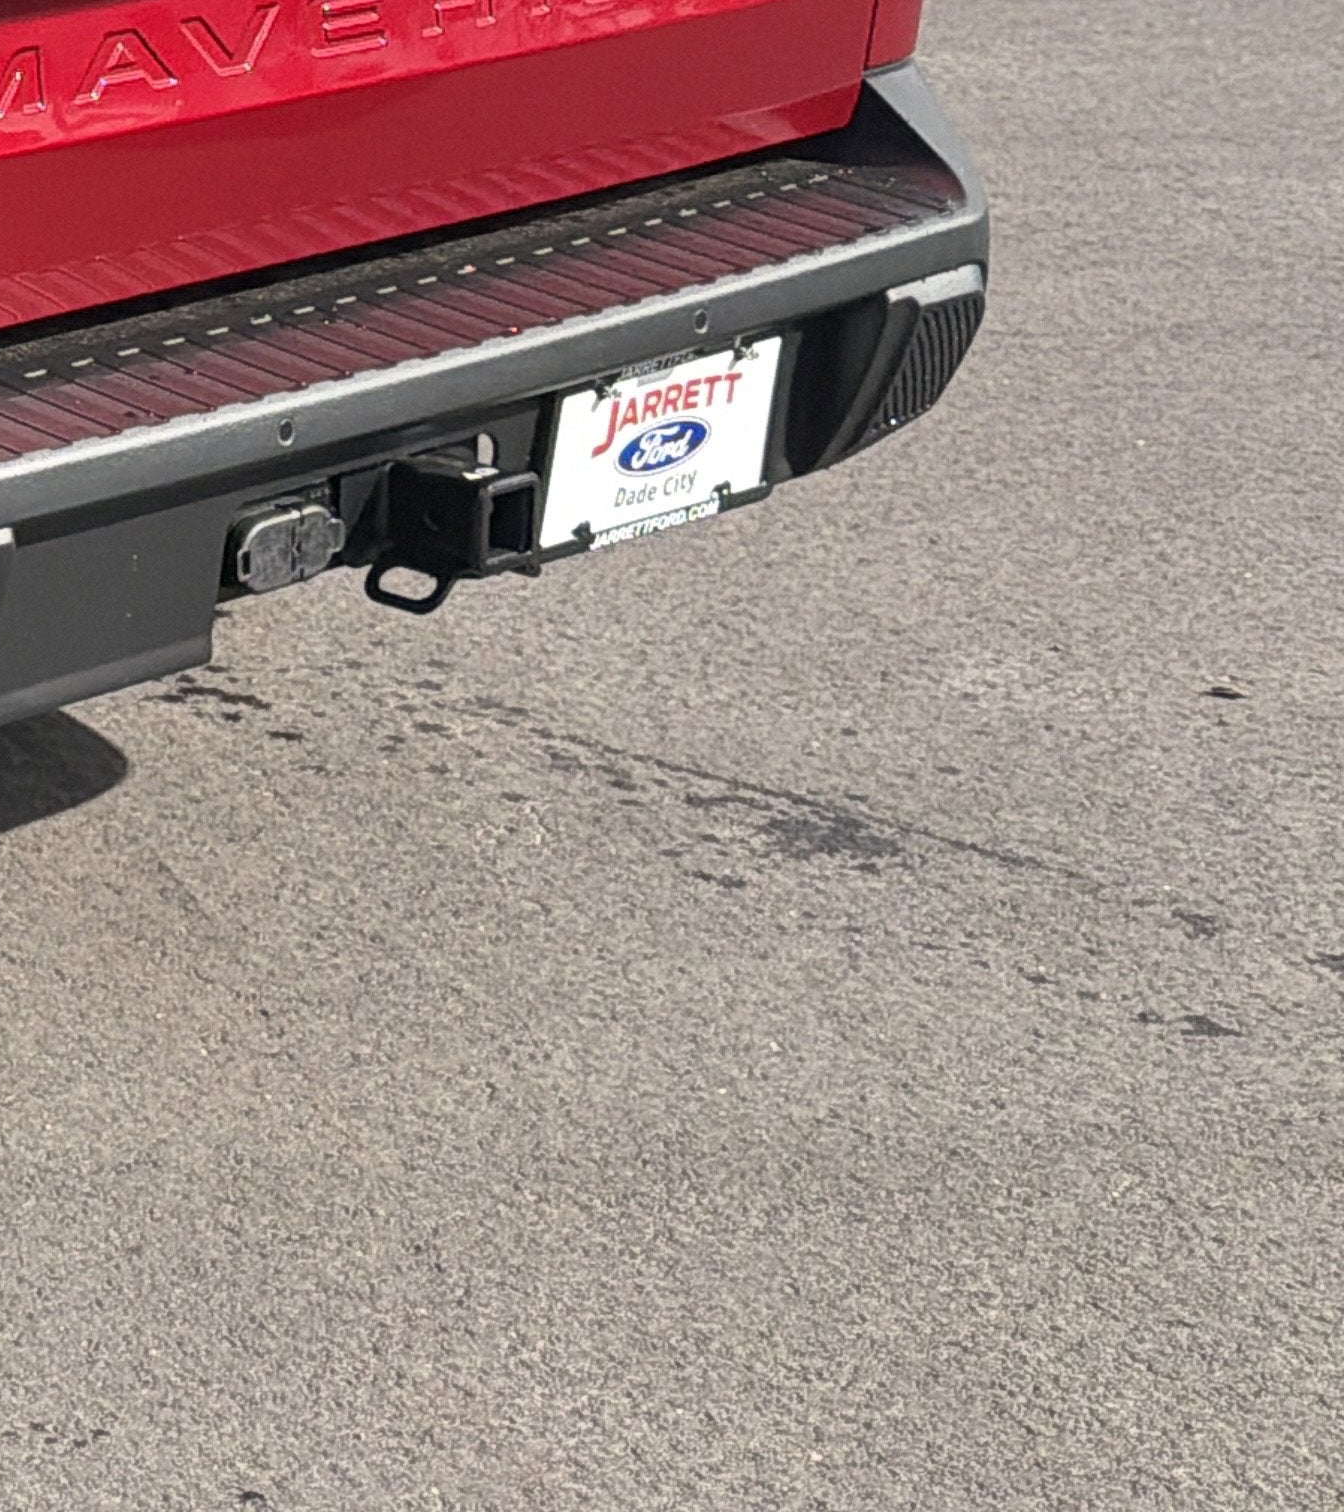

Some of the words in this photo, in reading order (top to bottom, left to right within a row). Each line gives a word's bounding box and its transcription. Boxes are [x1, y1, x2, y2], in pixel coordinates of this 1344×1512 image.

[591, 372, 744, 458] JARRETT
[630, 423, 694, 470] Ford
[614, 482, 657, 507] Dade
[663, 469, 698, 495] City
